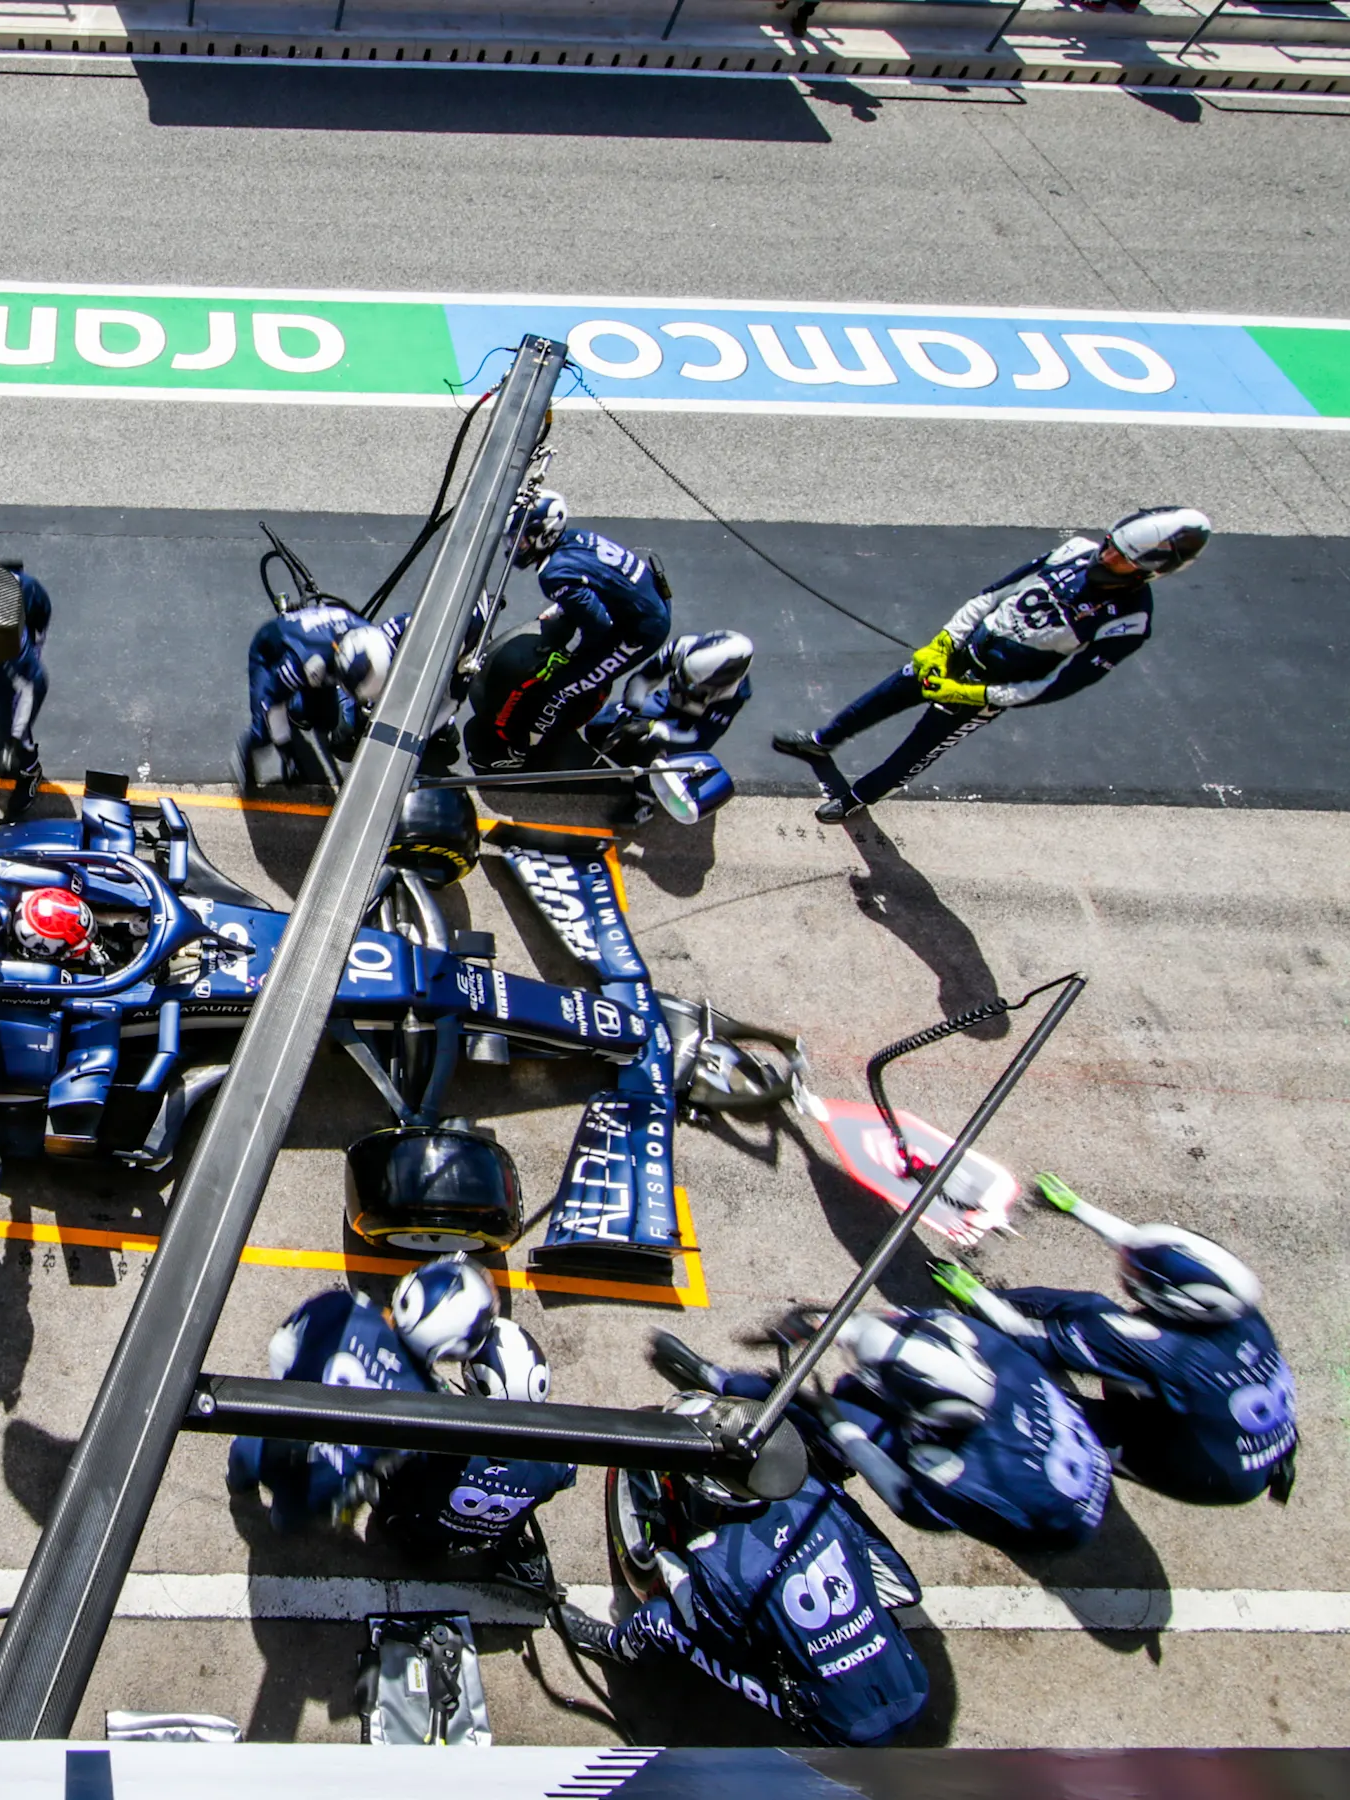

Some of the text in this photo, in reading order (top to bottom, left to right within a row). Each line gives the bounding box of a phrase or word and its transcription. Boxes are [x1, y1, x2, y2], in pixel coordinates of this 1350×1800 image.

[565, 319, 1177, 395] aramco
[533, 654, 626, 734] ALPHATAURI
[348, 941, 394, 983] 10
[573, 990, 589, 1036] myWorld
[561, 1101, 631, 1243] ALPHA
[765, 1532, 825, 1579] SCUDERIA
[806, 1604, 875, 1658] ALPHATAURI
[818, 1633, 887, 1679] HONDA
